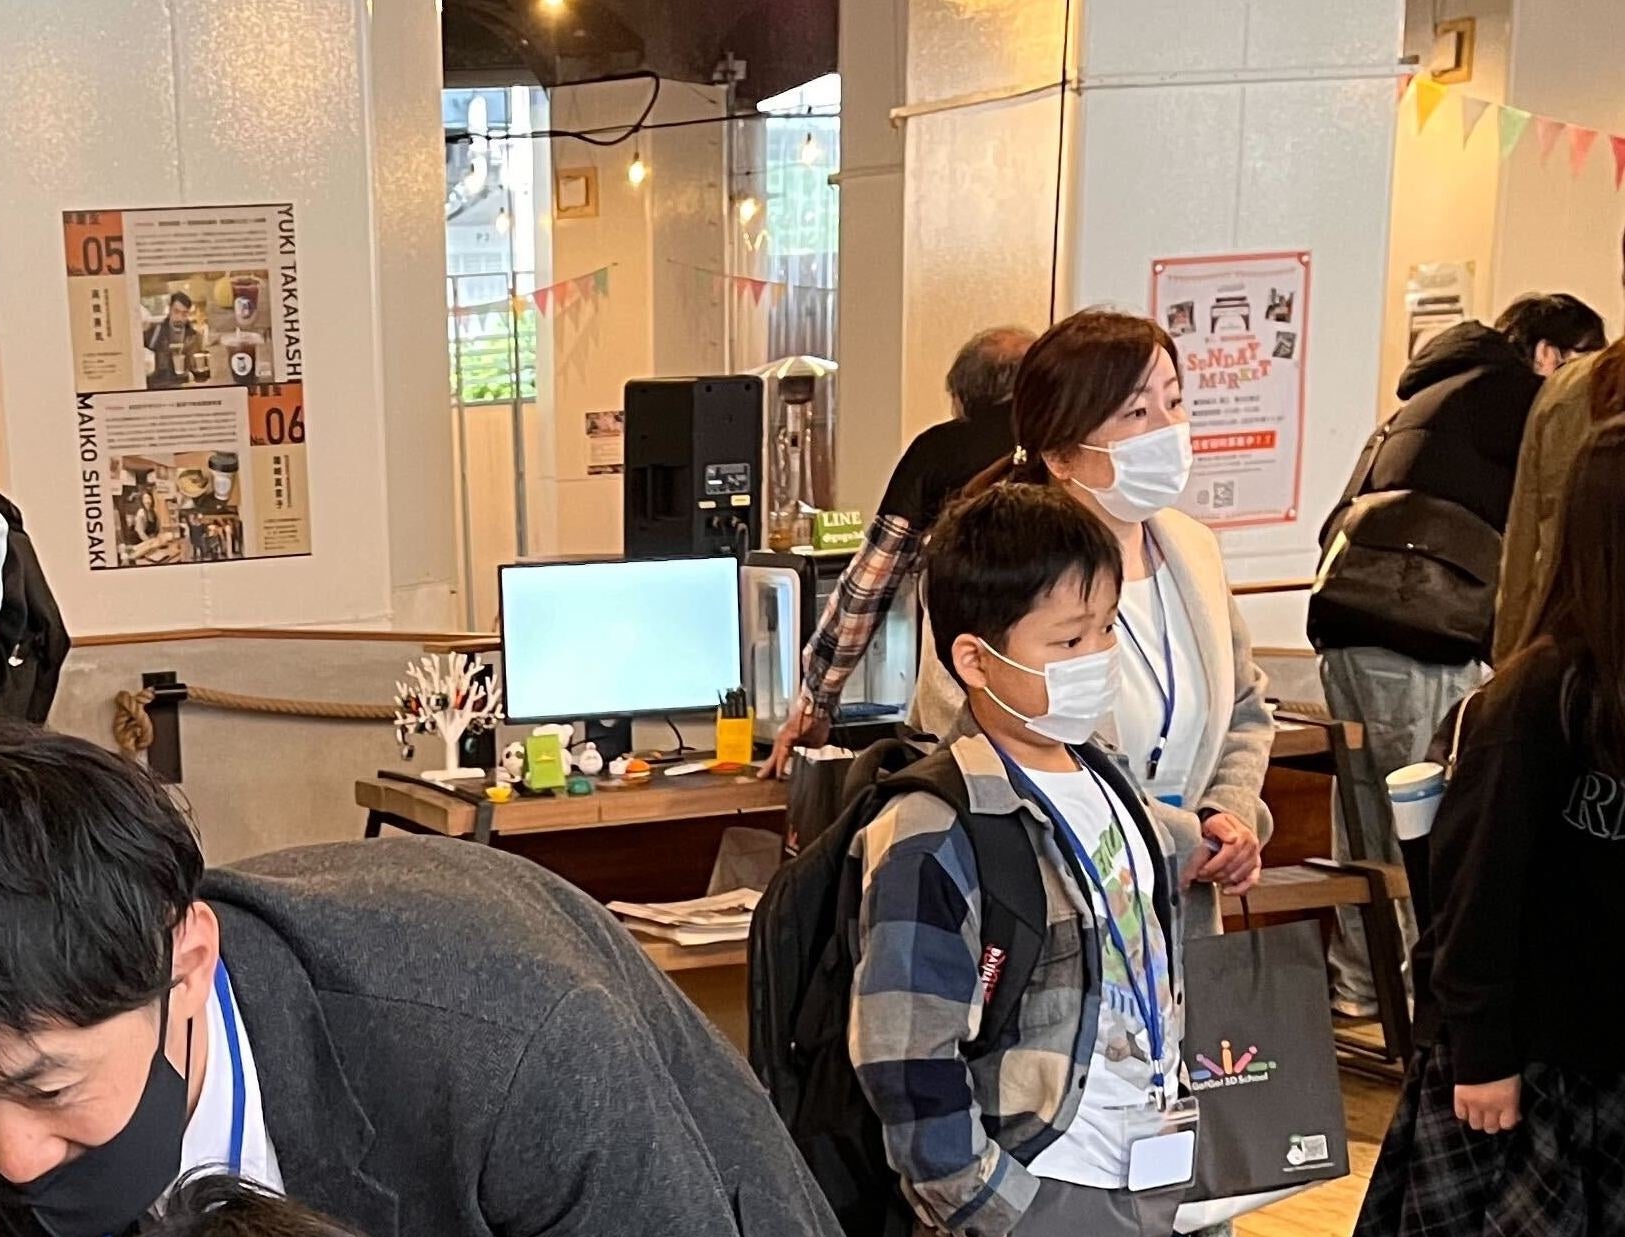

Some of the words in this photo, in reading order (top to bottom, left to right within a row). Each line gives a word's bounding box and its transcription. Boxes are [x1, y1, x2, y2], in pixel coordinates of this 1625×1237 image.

[277, 204, 296, 255] YUKI
[83, 236, 125, 275] 05
[281, 261, 303, 384] TAKAHASHI
[1187, 342, 1260, 371] SUNDAY
[1199, 360, 1271, 389] MARKET
[76, 393, 97, 462] MAIKO
[266, 405, 305, 445] 06
[83, 470, 106, 570] SHIOSAKI
[822, 511, 863, 527] LINE
